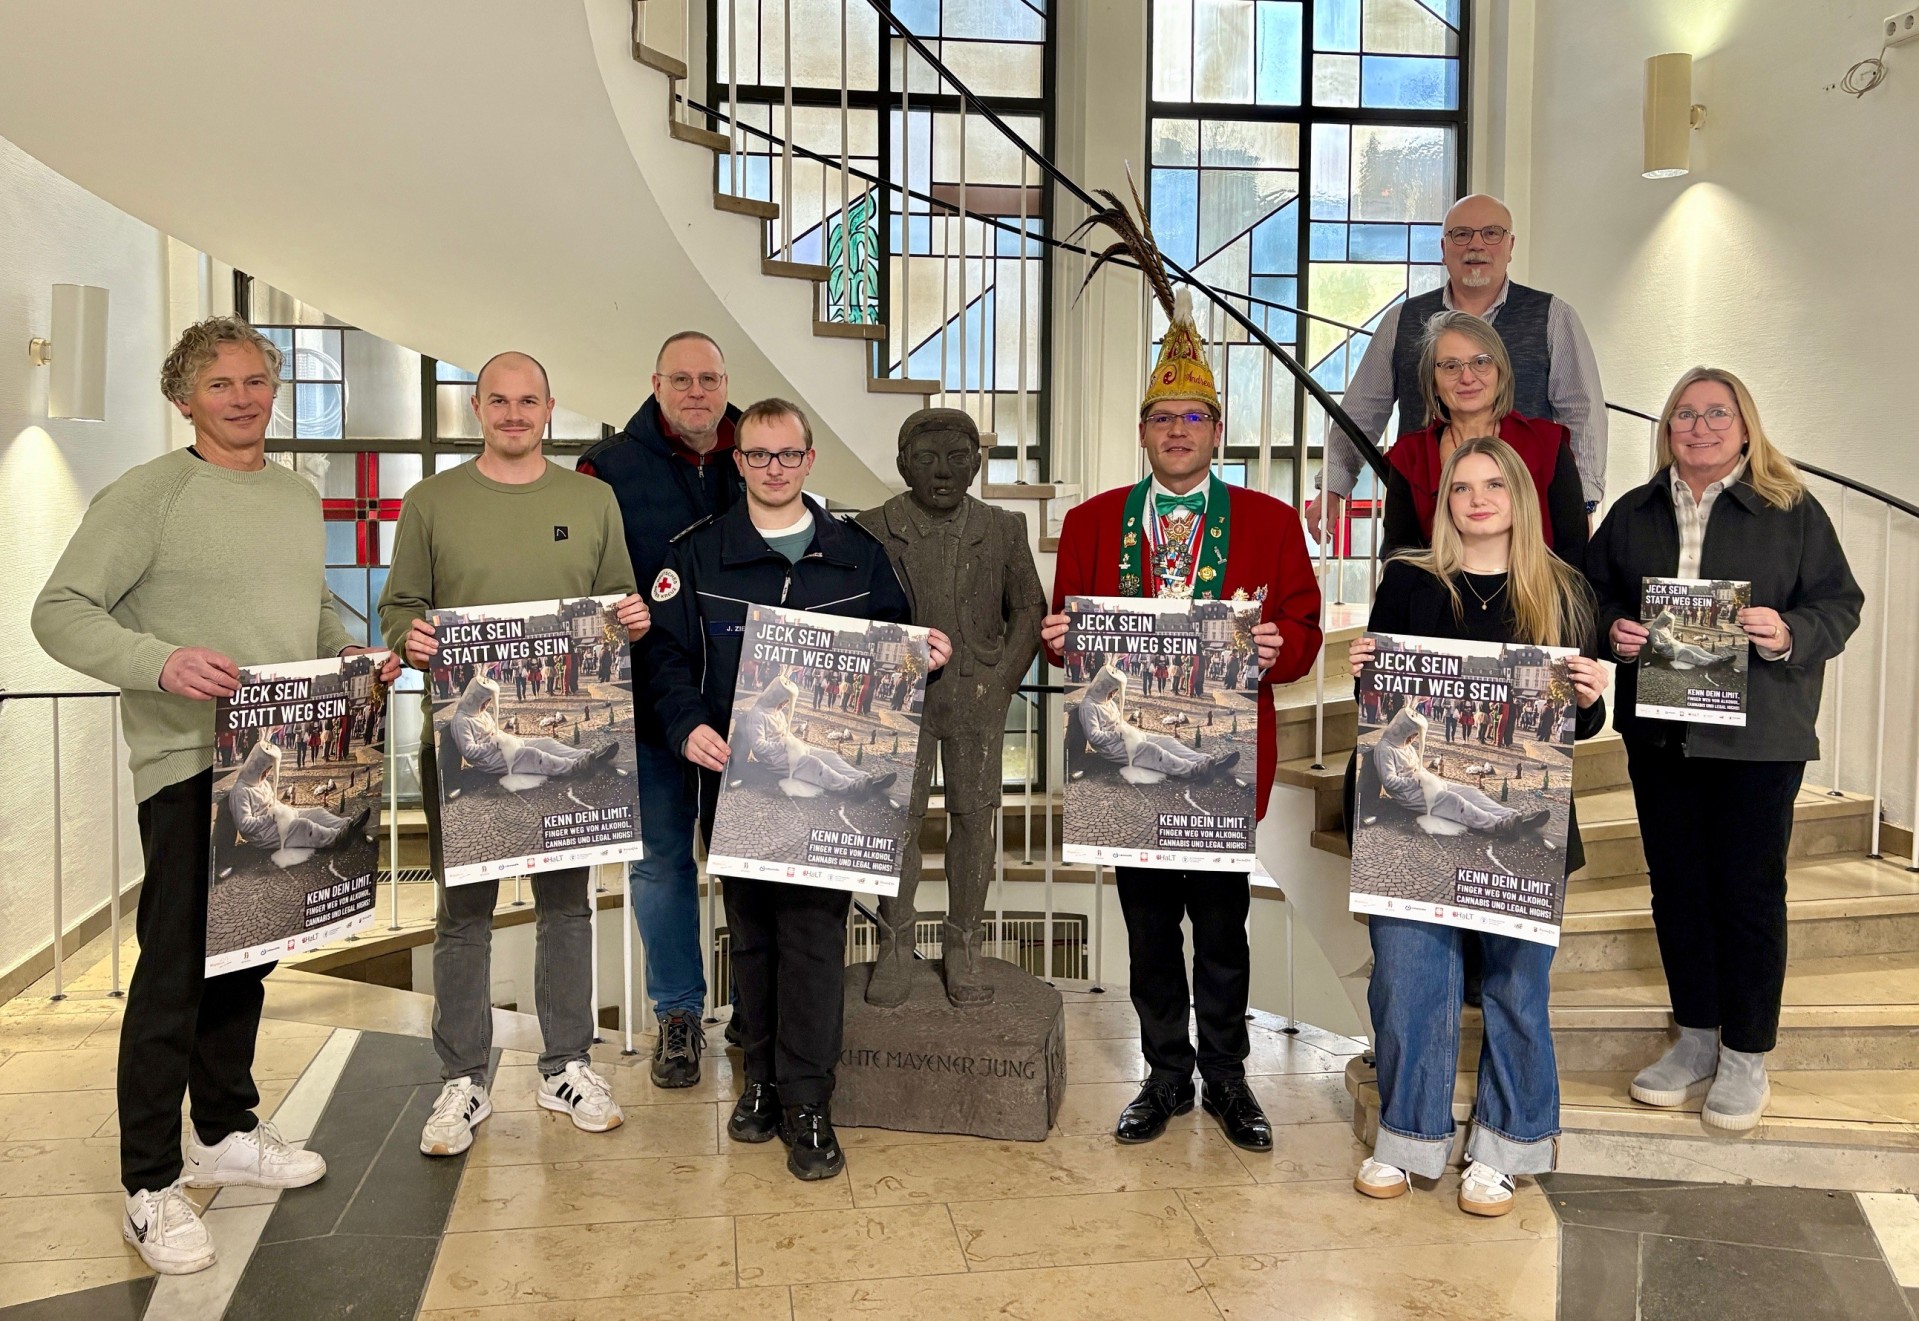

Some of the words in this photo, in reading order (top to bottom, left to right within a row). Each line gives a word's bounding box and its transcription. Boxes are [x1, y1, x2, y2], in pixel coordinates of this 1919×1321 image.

[1646, 585, 1666, 593] JECK
[1669, 586, 1687, 595] SEIN
[1646, 596, 1670, 604] STATT
[1672, 597, 1690, 606] WEG
[1692, 598, 1712, 607] SEIN
[441, 625, 482, 644] JECK
[487, 621, 521, 639] SEIN
[1077, 614, 1114, 631] JECK
[1120, 616, 1152, 632] SEIN
[757, 624, 794, 643] JECK
[798, 629, 831, 648] SEIN
[1077, 635, 1121, 651] STATT
[1126, 636, 1158, 653] WEG
[1164, 638, 1196, 654] SEIN
[443, 645, 490, 665] STATT
[495, 642, 529, 660] WEG
[534, 638, 568, 656] SEIN
[754, 644, 798, 663] STATT
[803, 650, 833, 669] WEG
[838, 656, 870, 674] SEIN
[1375, 653, 1416, 672] JECK
[1421, 656, 1458, 675] SEIN
[229, 685, 270, 705] JECK
[275, 681, 308, 700] SEIN
[1374, 674, 1423, 694] STATT
[1428, 679, 1464, 698] WEG
[1470, 683, 1507, 702] SEIN
[229, 707, 276, 729] STATT
[281, 703, 312, 723] WEG
[318, 699, 346, 719] SEIN
[544, 814, 572, 827] KENN
[576, 810, 598, 823] DEIN
[602, 807, 631, 820] LIMIT.
[1160, 815, 1187, 826] KENN
[1191, 816, 1214, 827] DEIN
[1217, 817, 1246, 828] LIMIT.
[545, 829, 568, 838] FINGER
[571, 826, 584, 834] WEG
[601, 821, 631, 830] ALKOHOL,
[545, 838, 576, 848] CANNABIS
[578, 835, 590, 843] UND
[592, 833, 611, 842] LEGAL
[613, 831, 632, 839] HIGHS!
[811, 829, 838, 843] KENN
[841, 833, 864, 846] DEIN
[867, 837, 894, 851] LIMIT.
[1216, 831, 1246, 839] ALKOHOL,
[810, 844, 831, 853] FINGER
[834, 847, 847, 855] WEG
[864, 852, 893, 862] ALKOHOL,
[1160, 839, 1189, 847] CANNABIS
[808, 855, 838, 864] CANNABIS
[853, 861, 871, 869] LEGAL
[872, 864, 892, 872] HIGHS!
[307, 889, 330, 905] KENN
[332, 884, 349, 900] DEIN
[352, 874, 371, 892] LIMIT.
[1459, 869, 1488, 885] KENN
[1492, 875, 1517, 889] DEIN
[1521, 879, 1552, 896] LIMIT.
[306, 906, 325, 916] FINGER
[327, 901, 338, 910] WEG
[339, 899, 349, 907] VON
[350, 891, 370, 902] ALKOHOL,
[1458, 884, 1482, 895] FINGER
[1485, 889, 1500, 897] WEG
[1502, 891, 1516, 900] VON
[1518, 896, 1552, 908] ALKOHOL,
[306, 914, 330, 927] CANNABIS
[332, 910, 341, 918] UND
[342, 906, 356, 915] LEGAL
[1457, 896, 1489, 907] CANNABIS
[1492, 901, 1505, 910] UND
[1507, 904, 1527, 914] LEGAL
[1529, 908, 1551, 919] HIGHS!
[841, 1049, 880, 1068] CHTE
[886, 1051, 975, 1075] MAYENER
[979, 1058, 1035, 1080] JUNG
